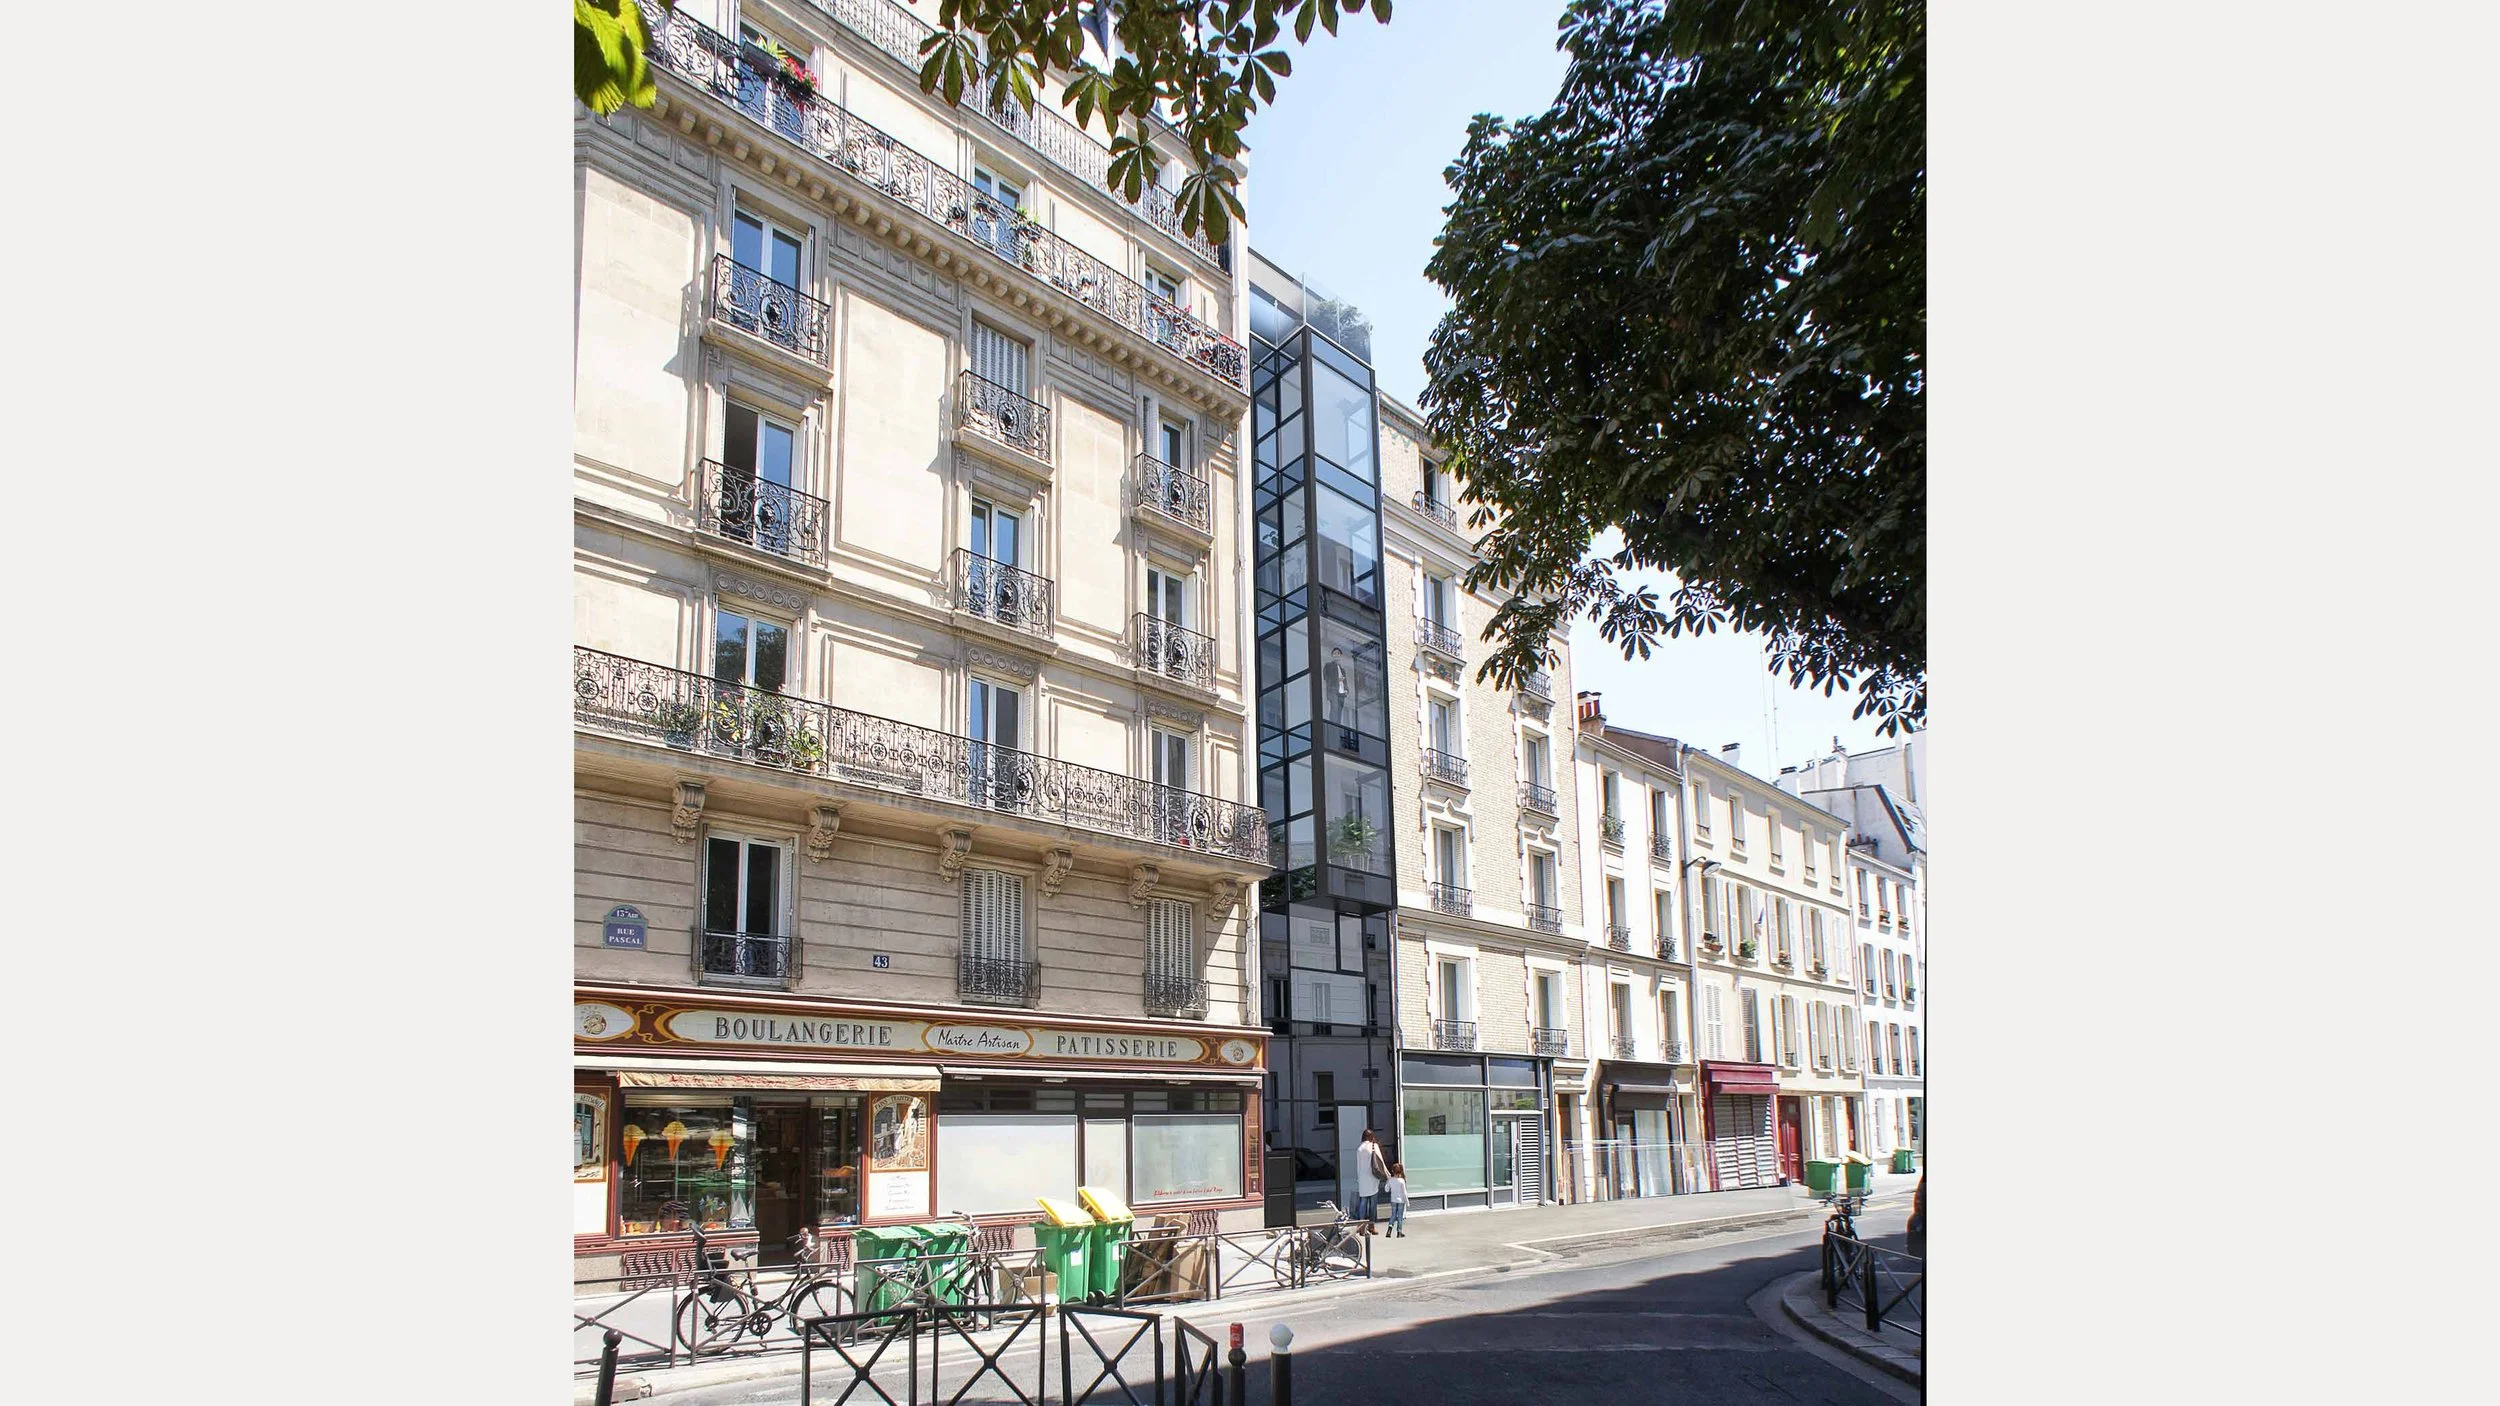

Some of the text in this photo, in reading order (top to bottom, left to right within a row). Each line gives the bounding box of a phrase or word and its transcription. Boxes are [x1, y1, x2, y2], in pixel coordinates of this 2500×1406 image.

[609, 936, 643, 944] PASCAL
[874, 956, 888, 968] 43
[714, 1016, 893, 1046] BOULANGERIE
[937, 1028, 1021, 1049] Maître Artisan
[1056, 1035, 1178, 1058] PATISSERIE
